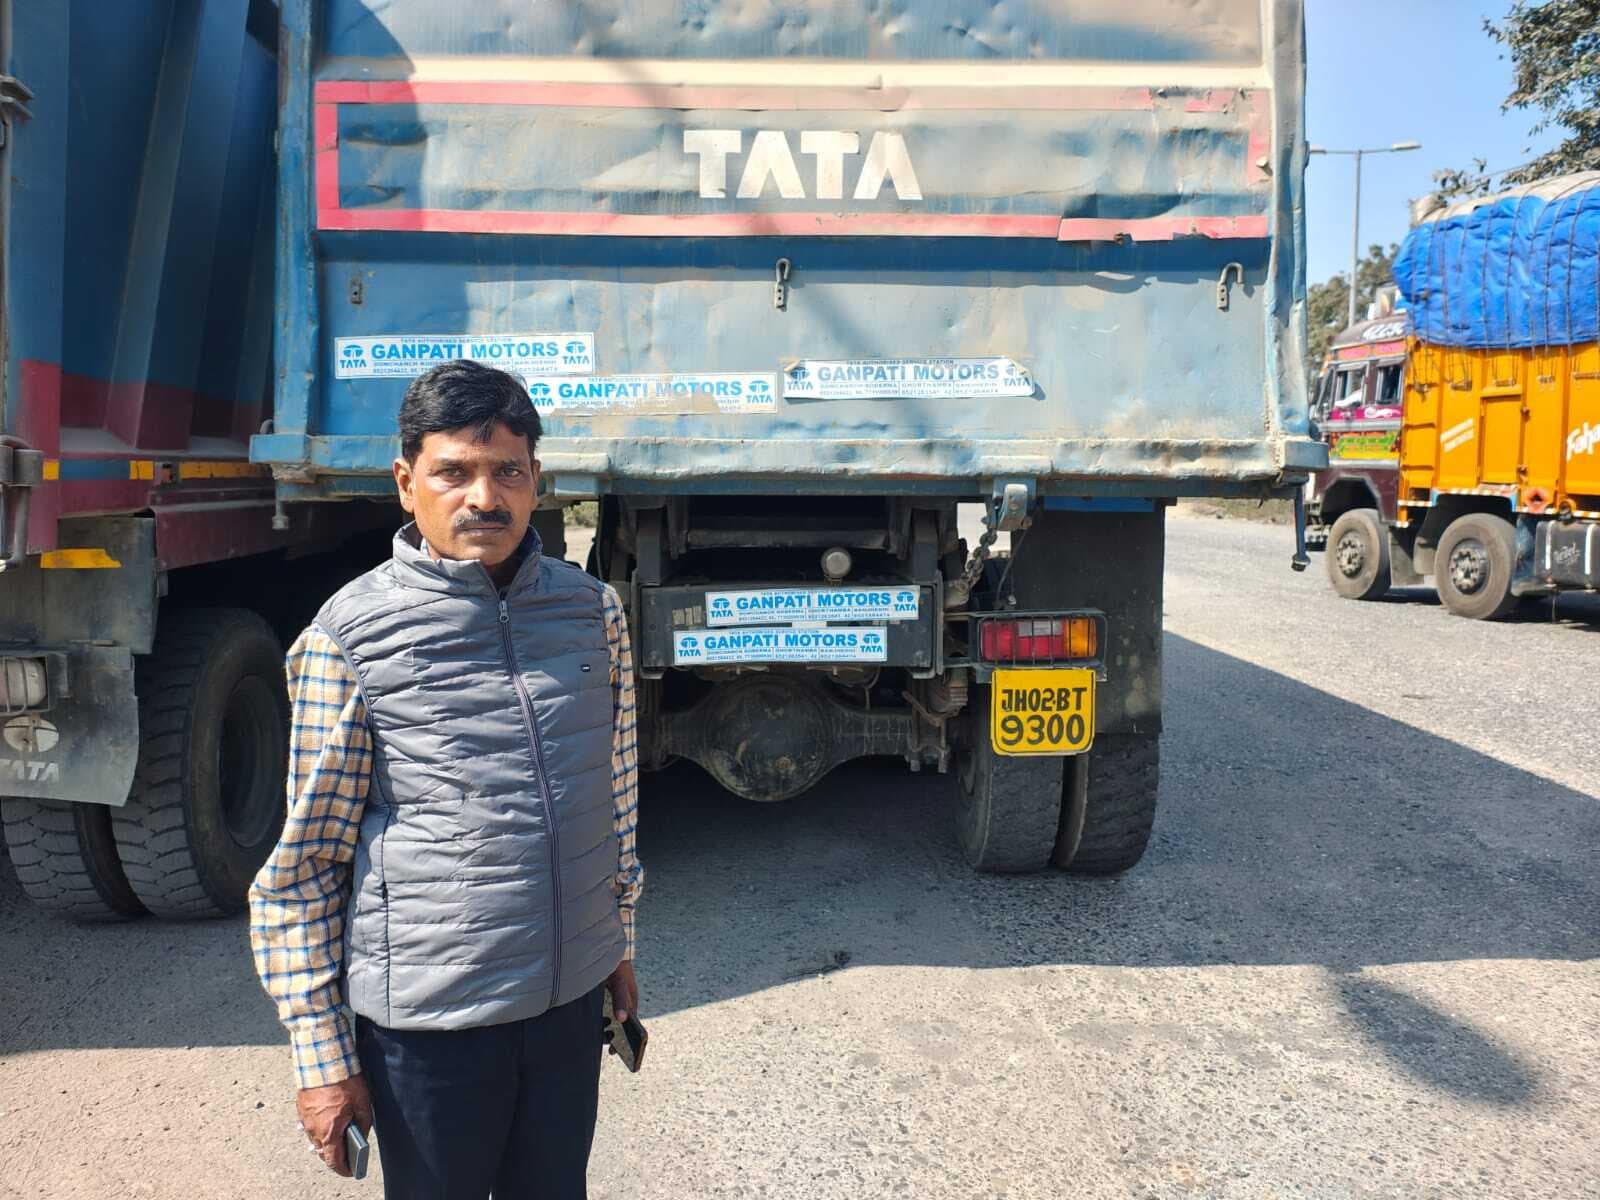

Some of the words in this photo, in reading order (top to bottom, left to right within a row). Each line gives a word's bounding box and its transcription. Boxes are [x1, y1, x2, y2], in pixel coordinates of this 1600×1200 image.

[683, 130, 923, 200] TATA
[371, 344, 463, 359] GANPATI
[471, 342, 559, 358] MOTORS
[340, 359, 367, 368] TATA
[562, 355, 590, 364] TATA
[818, 366, 905, 382] GANPATI
[913, 364, 999, 380] MOTORS
[787, 381, 813, 390] TATA
[1004, 377, 1031, 387] TATA
[558, 383, 648, 398] GANPATI
[656, 380, 742, 397] MOTORS
[530, 397, 554, 405] ATA
[747, 395, 773, 404] TATA
[736, 596, 811, 610] GANPATI
[818, 593, 891, 607] MOTORS
[894, 602, 917, 611] TATA
[710, 609, 733, 618] TATA
[704, 635, 778, 648] GANPATI
[785, 633, 857, 647] MOTORS
[678, 648, 701, 657] TATA
[860, 644, 882, 653] TATA
[1001, 713, 1085, 745] 9300
